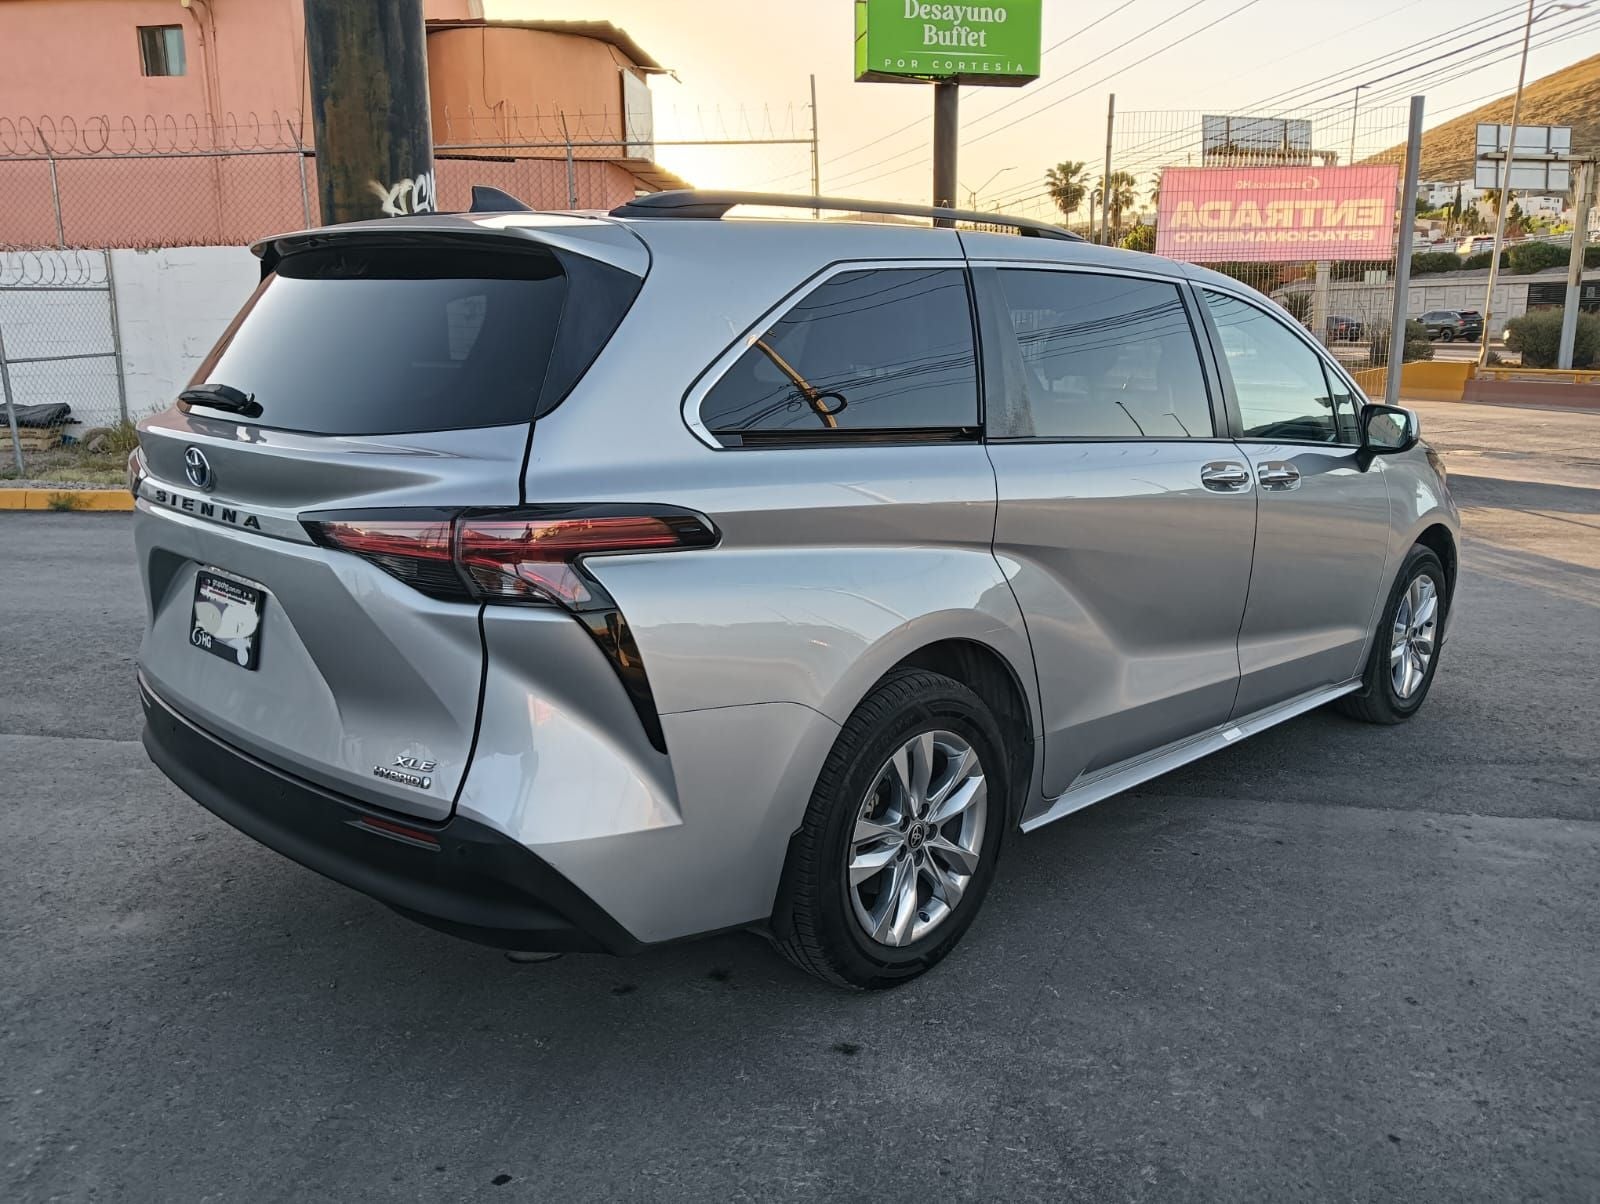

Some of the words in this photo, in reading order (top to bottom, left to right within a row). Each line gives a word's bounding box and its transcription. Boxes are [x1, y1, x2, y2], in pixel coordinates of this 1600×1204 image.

[904, 0, 1007, 25] Desayuno
[923, 24, 987, 47] Buffet
[884, 58, 918, 68] POR
[932, 60, 1023, 72] CORTESÍA
[156, 490, 261, 530] SIENNA
[392, 756, 437, 773] XLE
[373, 765, 421, 787] HYBRID
